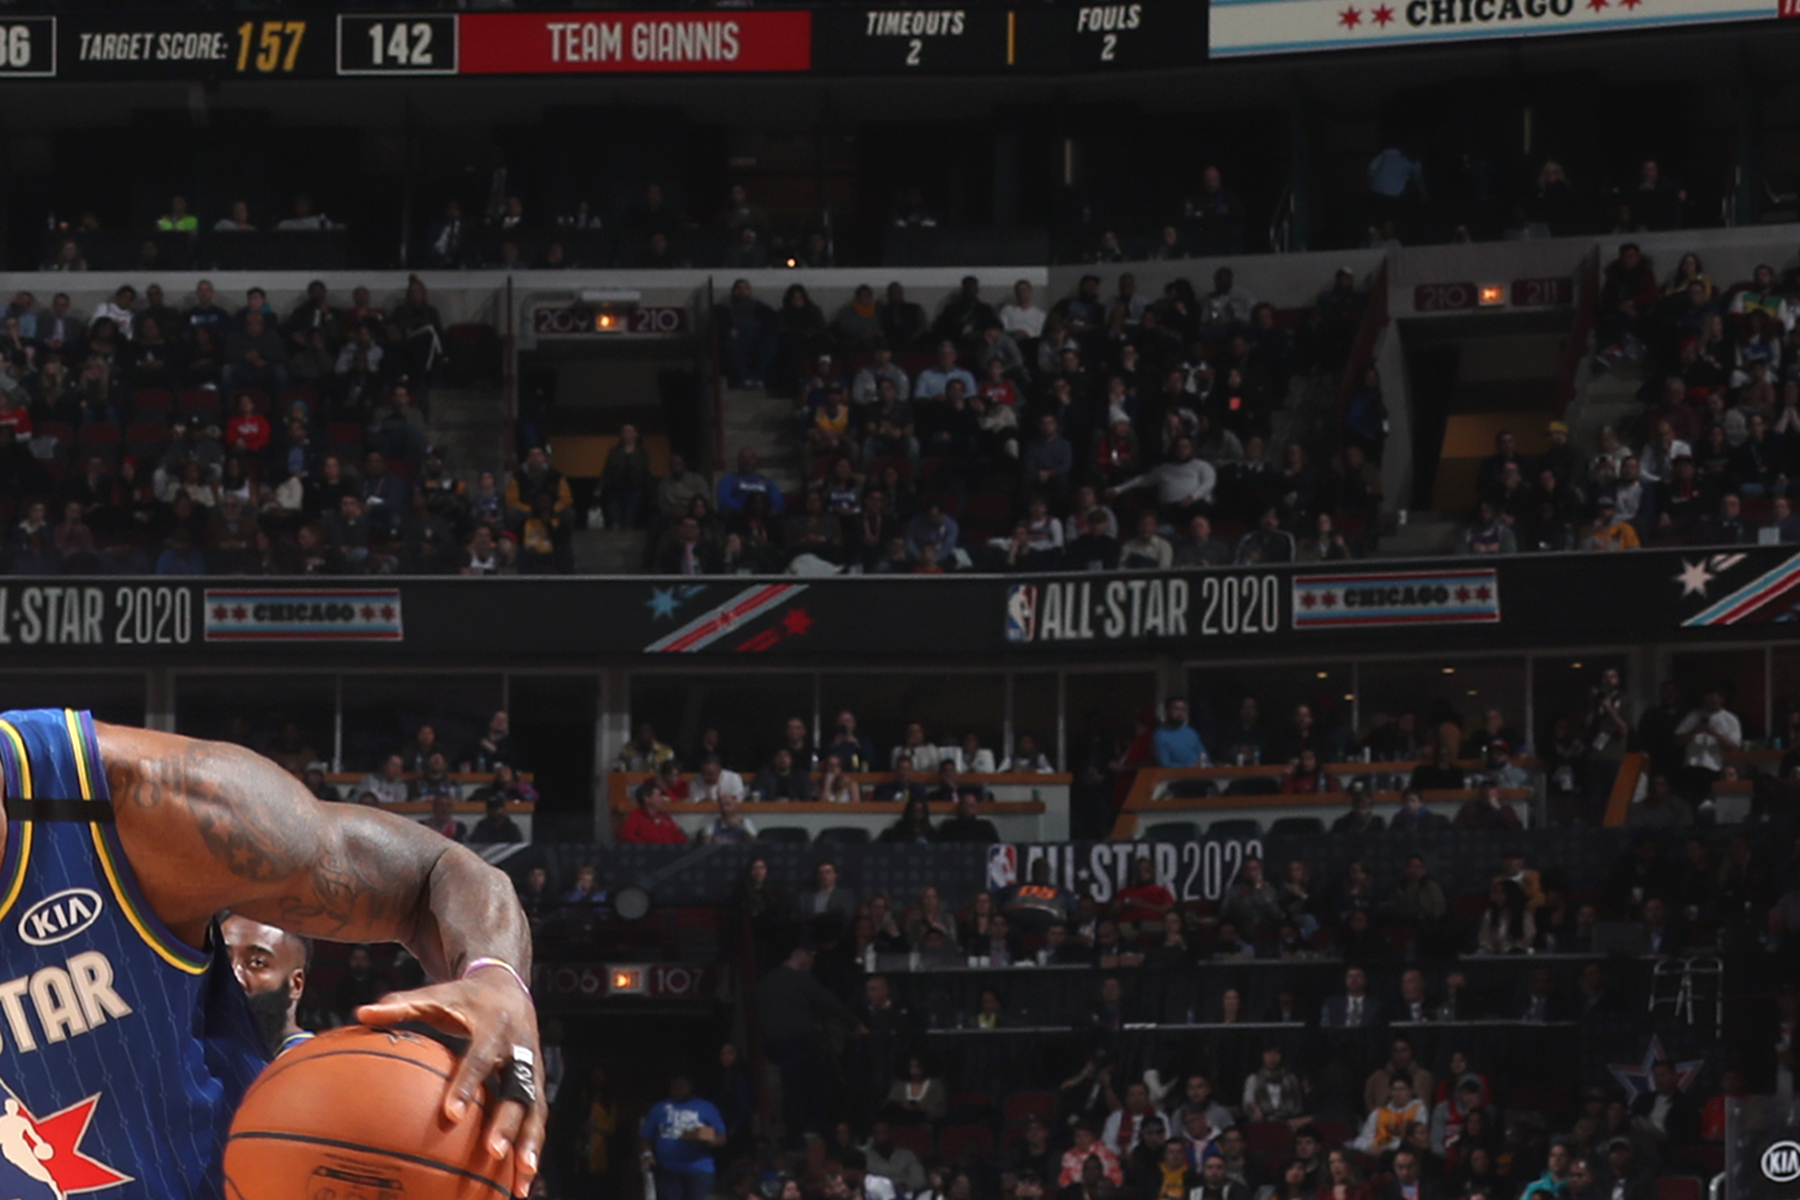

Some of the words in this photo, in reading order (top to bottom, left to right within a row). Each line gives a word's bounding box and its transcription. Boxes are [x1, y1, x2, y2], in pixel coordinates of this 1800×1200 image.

[866, 11, 966, 37] TIMEOUTS
[1077, 4, 1143, 33] FOULS
[1406, 0, 1574, 27] CHICAGO
[79, 32, 155, 62] TARGET
[156, 32, 229, 62] SCORE:
[236, 20, 307, 71] 157
[368, 22, 434, 66] 142
[546, 22, 623, 62] TEAM
[631, 20, 740, 62] GIANNIS
[905, 39, 923, 65] 2
[1100, 34, 1118, 60] 2
[636, 309, 680, 332] 210
[1201, 574, 1280, 638] 2020
[1343, 586, 1450, 608] CHICAGO
[114, 586, 193, 646] 2020
[252, 603, 356, 623] CHICAGO
[29, 896, 93, 939] KIA
[1769, 1149, 1800, 1174] KIA
